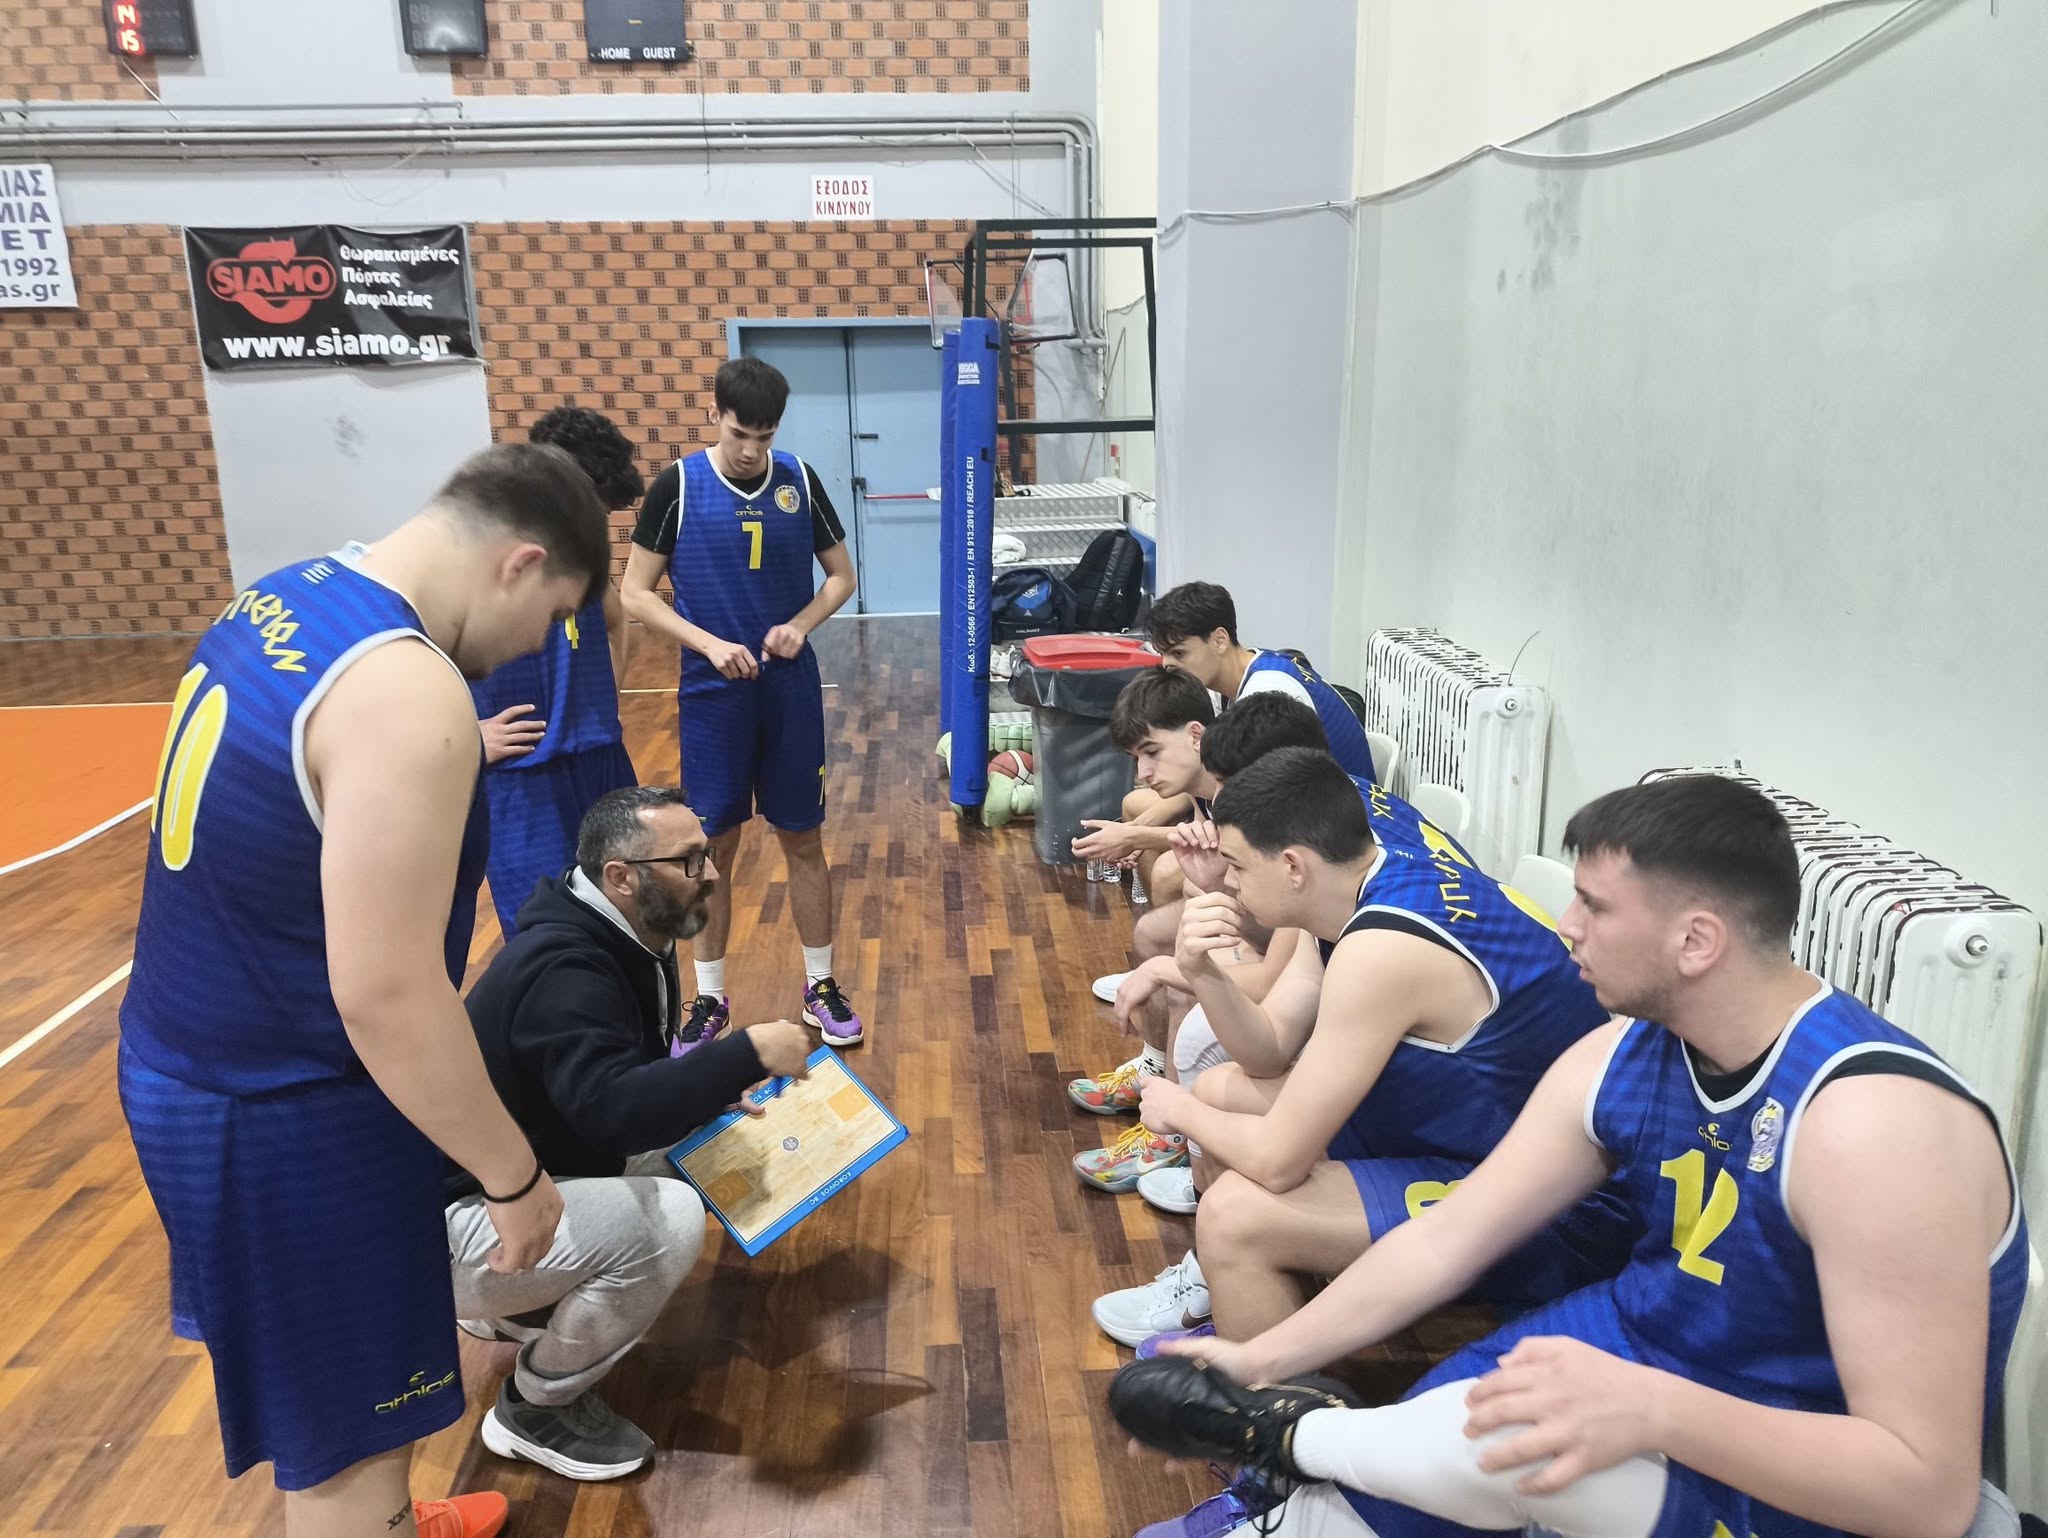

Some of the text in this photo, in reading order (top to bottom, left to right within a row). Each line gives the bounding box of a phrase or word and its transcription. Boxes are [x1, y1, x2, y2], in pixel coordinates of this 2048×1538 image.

[600, 47, 676, 60] HOME GUEST
[0, 170, 46, 197] ΙΑΣ
[816, 180, 868, 195] ΕΞΟΔΟΣ
[816, 200, 871, 215] ΚΙΝΔΥΝΟΥ
[1, 258, 59, 276] 1992
[341, 266, 401, 288] Πόρτες
[213, 264, 330, 296] SIAMO
[344, 289, 433, 311] Ασφαλείας
[222, 328, 452, 362] www.siamo.gr
[966, 456, 974, 469] EU
[966, 471, 974, 503] REACH
[741, 521, 763, 570] 7
[967, 548, 975, 560] EN
[1659, 1148, 1739, 1286] 12
